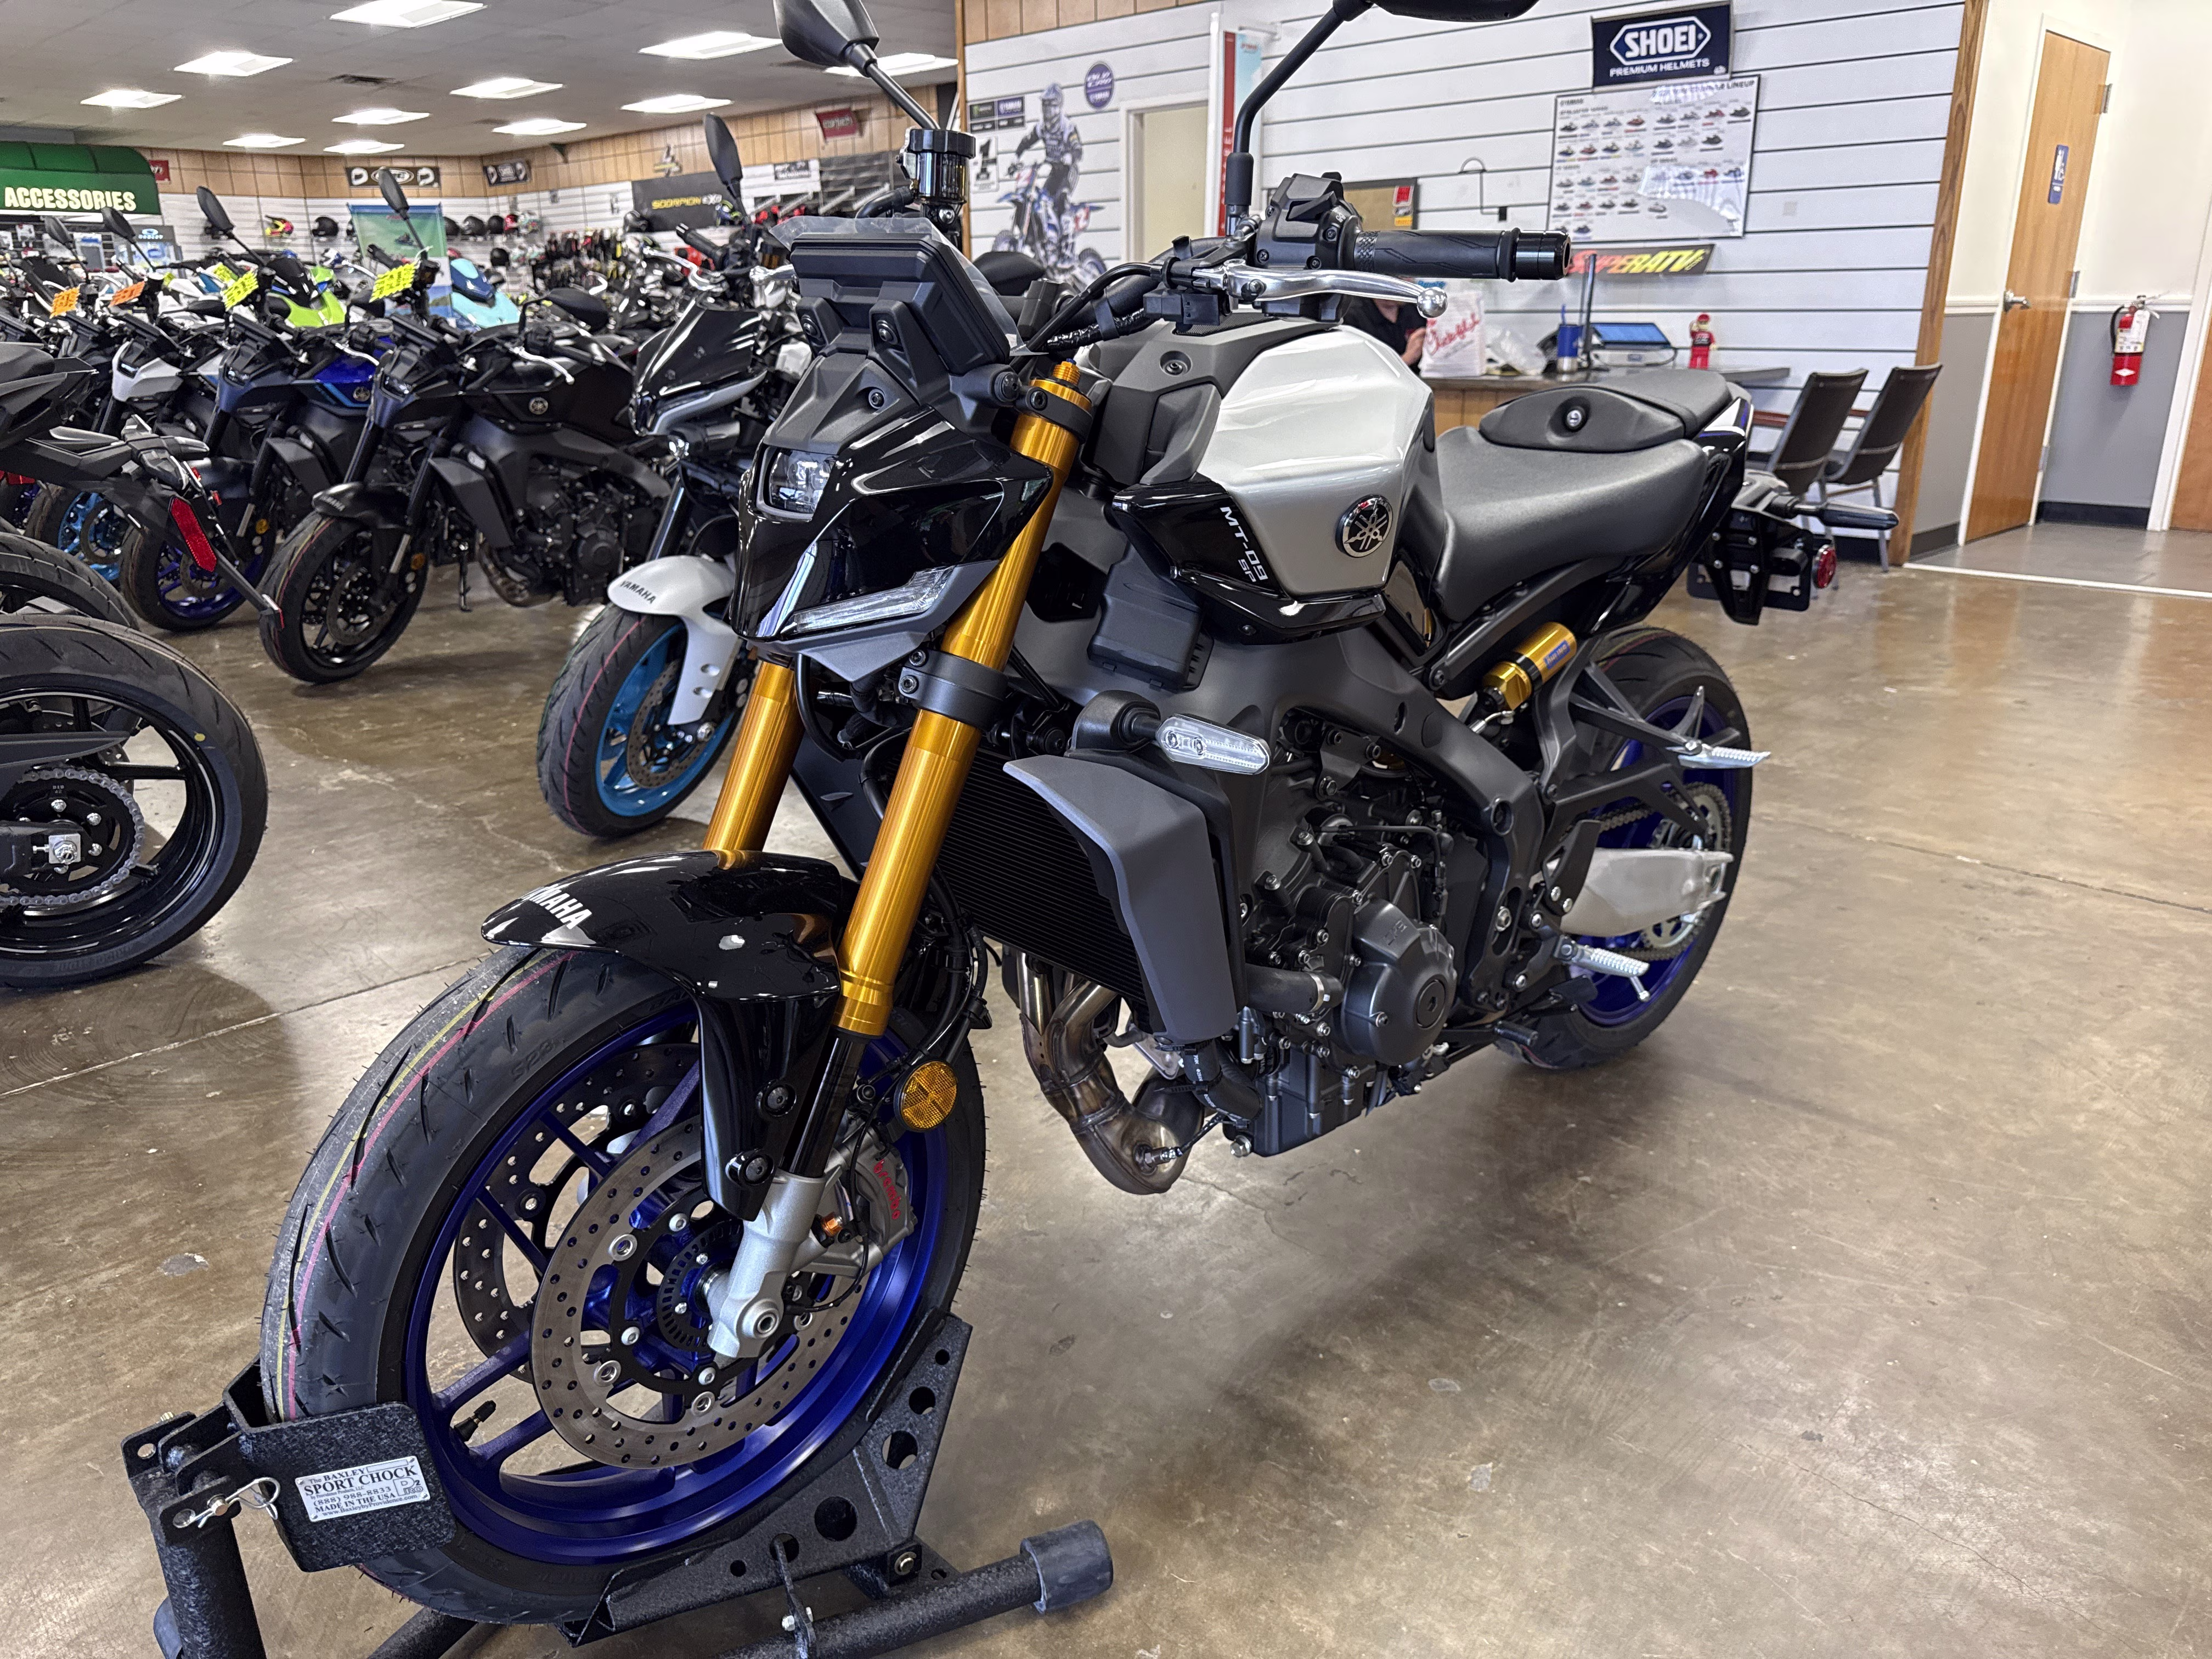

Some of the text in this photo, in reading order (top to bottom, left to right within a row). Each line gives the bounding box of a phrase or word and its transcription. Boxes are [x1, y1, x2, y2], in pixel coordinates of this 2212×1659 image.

[1624, 24, 1696, 58] SHOEI
[1610, 63, 1658, 77] PREMIUM
[1659, 58, 1711, 71] HELMETS
[5, 187, 137, 211] ACCESSORIES
[1220, 507, 1268, 580] MT-09
[1238, 559, 1256, 582] SP
[620, 580, 656, 604] YAMAHA
[873, 1159, 901, 1220] brembo
[304, 1465, 418, 1497] SPORT CHOCK
[323, 1468, 365, 1482] BAXLEY
[313, 1486, 391, 1508] (888) 988-8833
[314, 1504, 342, 1514] MADE
[356, 1496, 376, 1505] THE
[377, 1492, 396, 1501] USA
[321, 1494, 417, 1517] www.BaxleybyProvidence.com
